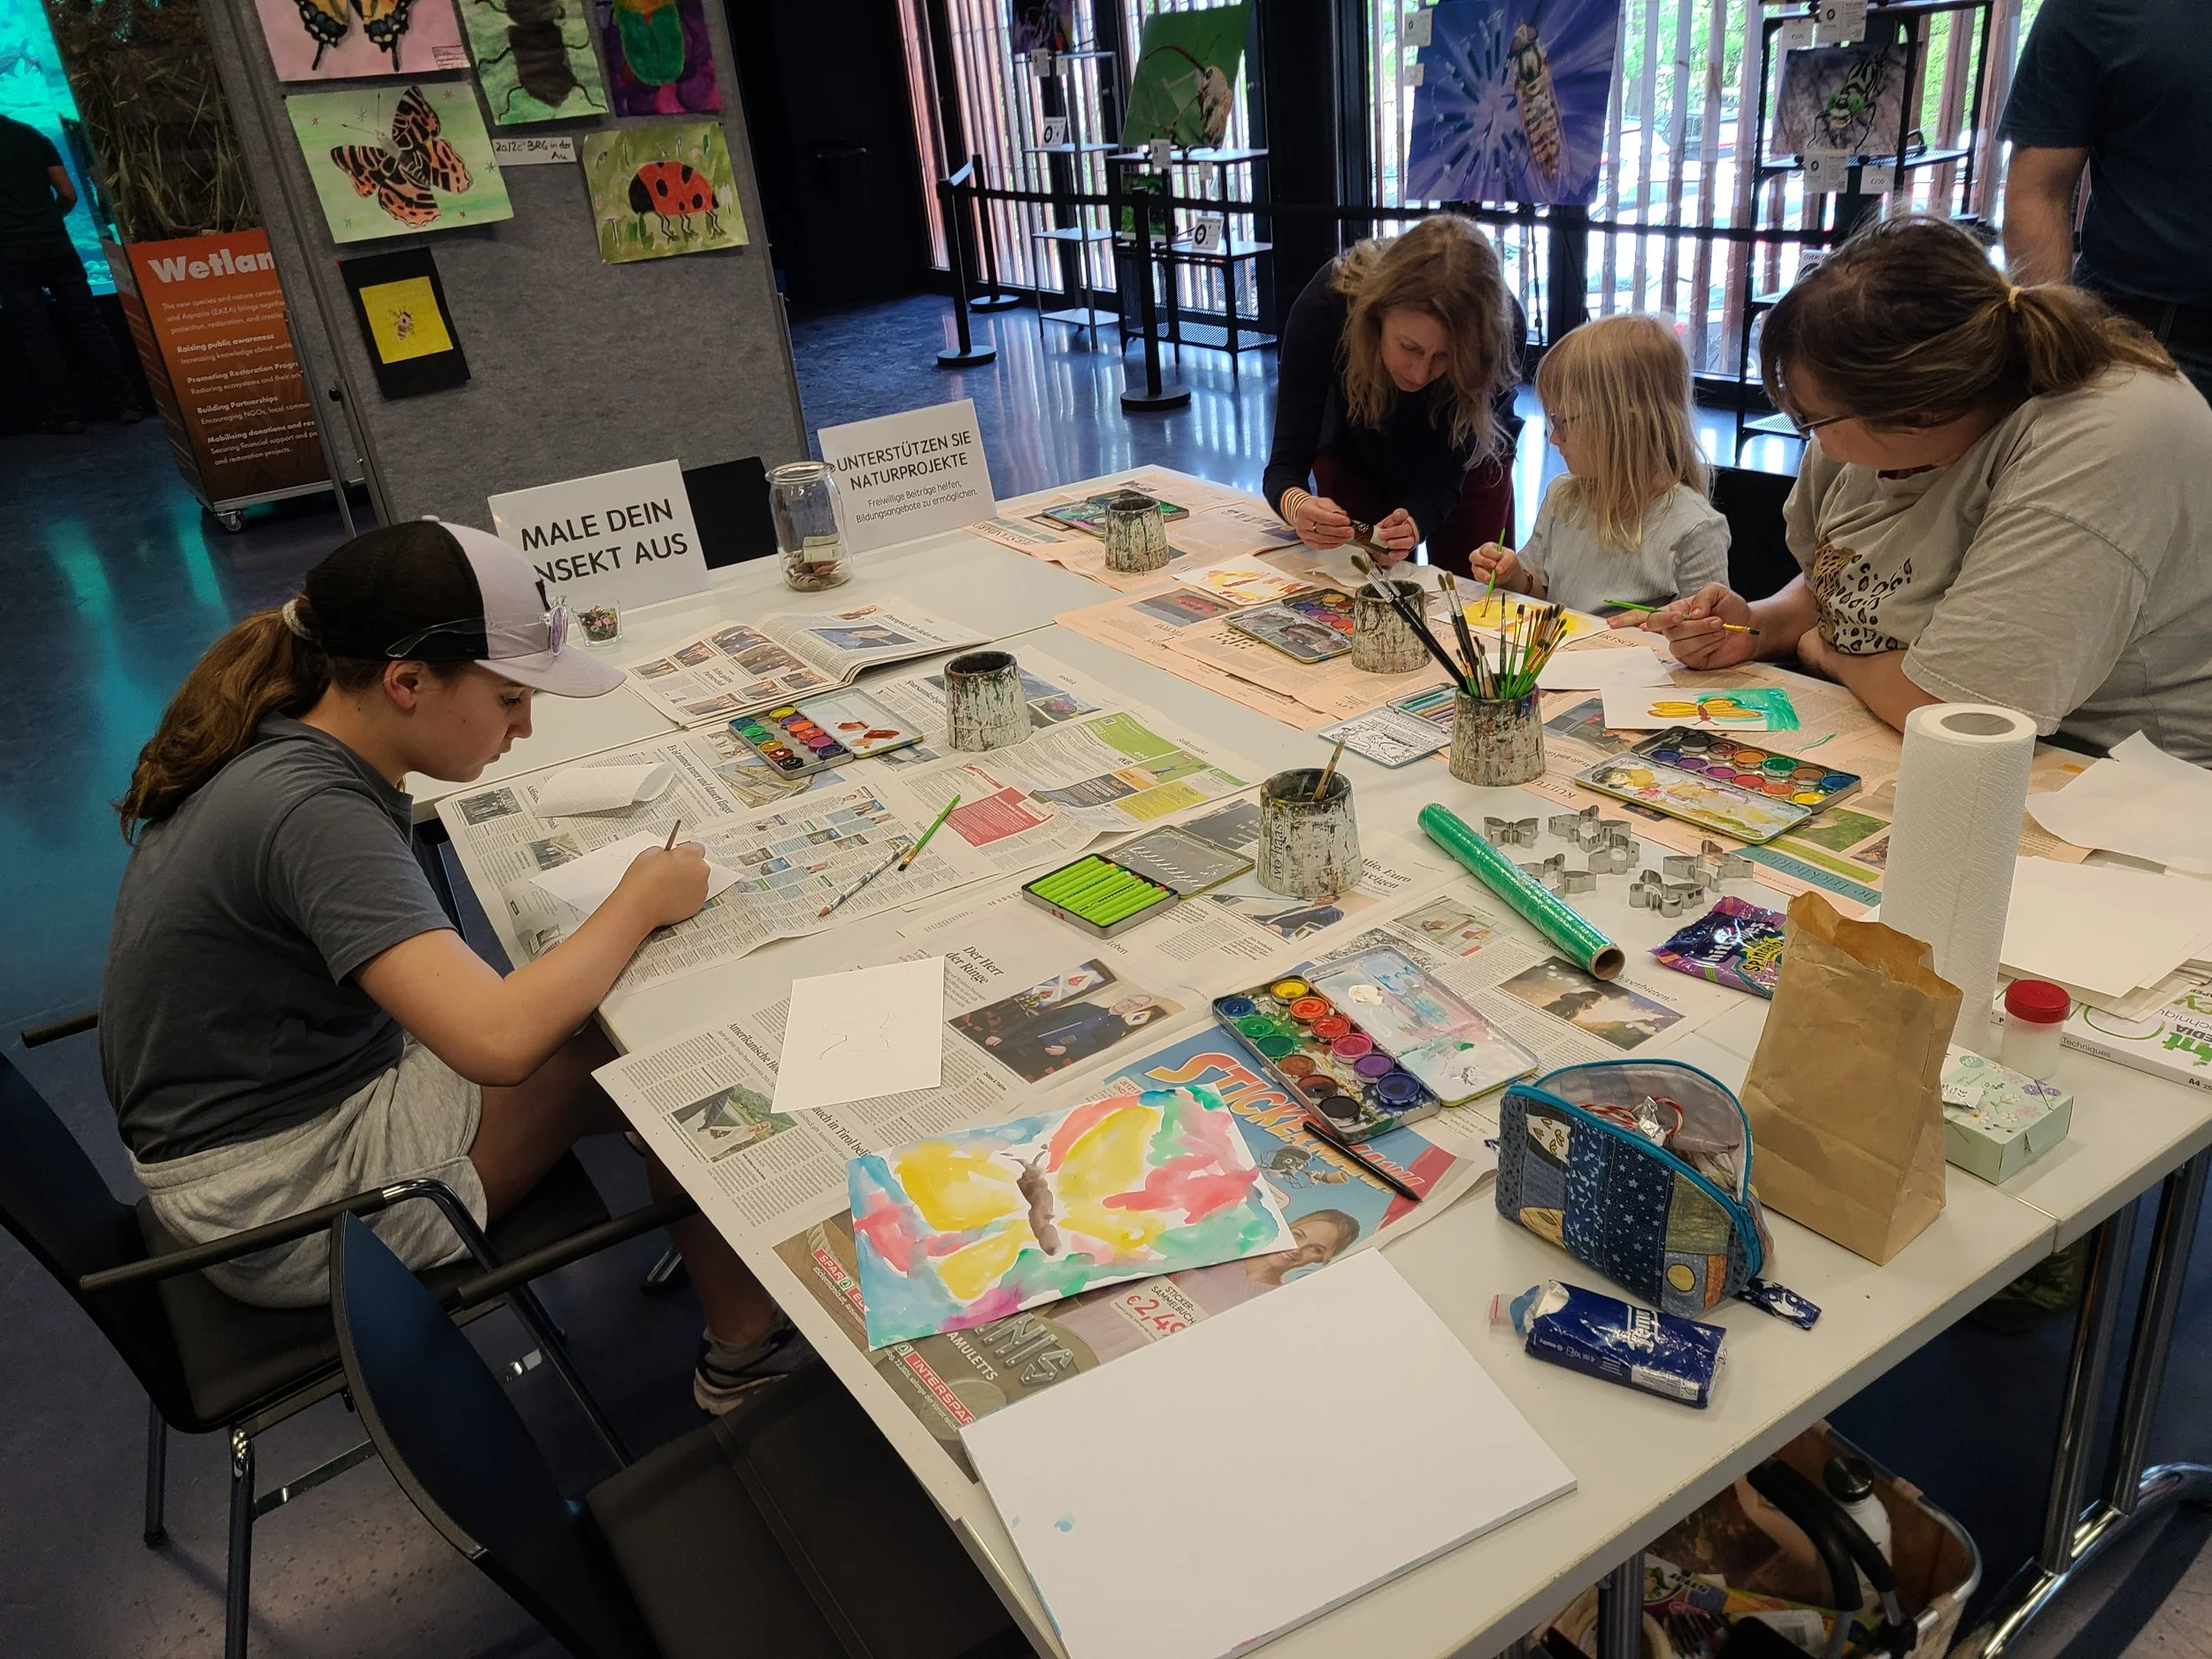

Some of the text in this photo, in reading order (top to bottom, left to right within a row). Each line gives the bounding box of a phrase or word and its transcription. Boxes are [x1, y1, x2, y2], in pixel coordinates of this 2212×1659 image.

[177, 334, 275, 354] Raising public awareness
[187, 373, 228, 385] Promoting
[229, 365, 274, 377] Restoration
[197, 396, 279, 415] Building Partnerships
[201, 412, 243, 425] Encouraging
[208, 431, 247, 444] Mobilising
[249, 425, 286, 436] donations
[288, 420, 302, 429] and
[211, 444, 240, 455] Securing
[229, 452, 264, 464] restoration
[836, 430, 972, 472] UNTERSTÜTZEN SIE
[850, 452, 968, 491] NATURPROJEKTE
[856, 488, 978, 524] Bildungsangebote zu ermöglichen.
[867, 480, 963, 509] Freiwillige Beiträge helfen,
[521, 498, 673, 552] MALE DEIN
[532, 532, 688, 585] NSEKT AUS
[1531, 780, 1577, 800] KULTU
[1271, 822, 1284, 880] ivo haas
[1380, 864, 1412, 884] Euro
[946, 951, 989, 985] der Ringe
[963, 946, 1004, 977] Der Herr
[1624, 977, 1678, 1003] verbieten?
[2062, 1037, 2112, 1059] Techniques
[726, 1022, 771, 1064] Amerikanische
[827, 1118, 840, 1132] in
[835, 1126, 857, 1146] Tirol
[2188, 1077, 2201, 1087] A4
[818, 1255, 844, 1281] SPAR
[1151, 1286, 1196, 1325] SAMMELBUCH
[1164, 1286, 1194, 1311] STICKER-
[947, 1332, 999, 1382] AMULETTS
